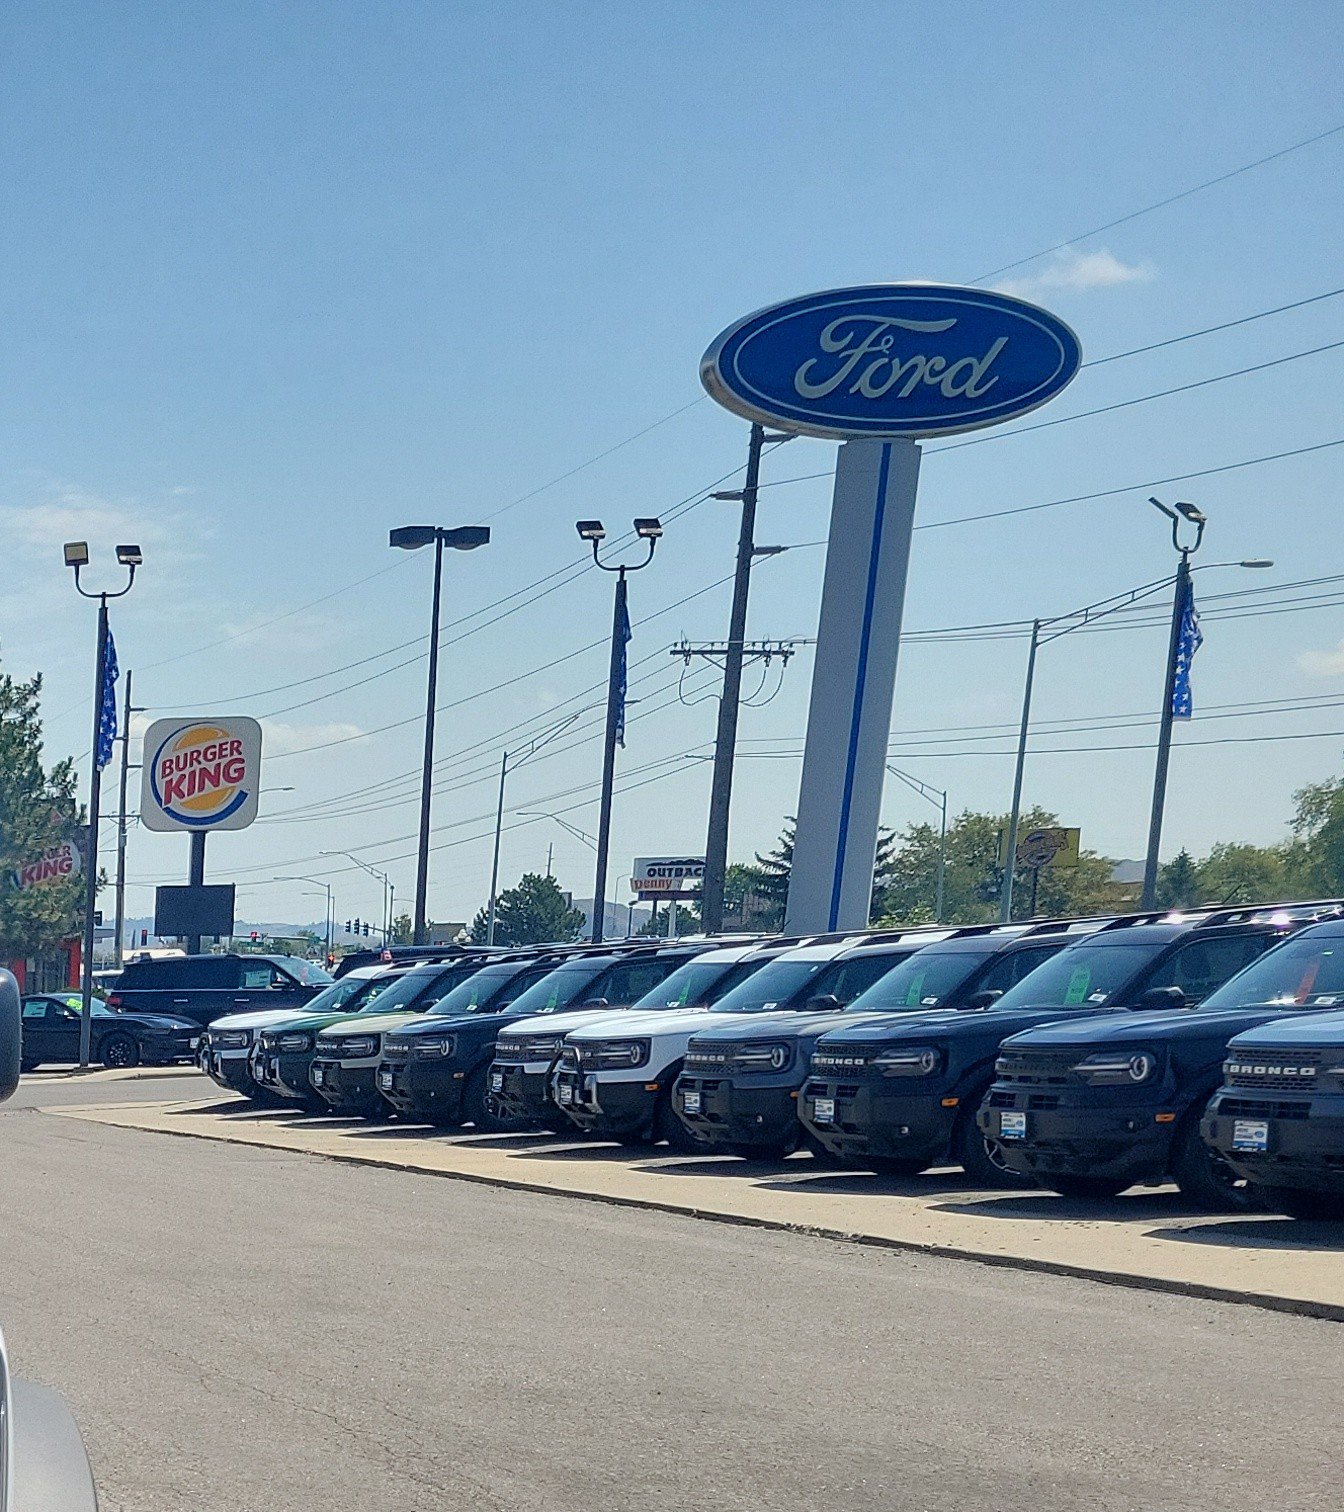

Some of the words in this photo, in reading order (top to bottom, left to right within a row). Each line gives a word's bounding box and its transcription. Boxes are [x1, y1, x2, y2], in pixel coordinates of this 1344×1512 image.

[794, 314, 1009, 400] Ford
[161, 739, 243, 779] BURGER
[163, 757, 246, 807] KING
[20, 857, 73, 887] KING
[646, 867, 706, 878] OUTBAC
[1229, 1065, 1317, 1076] BRONCO
